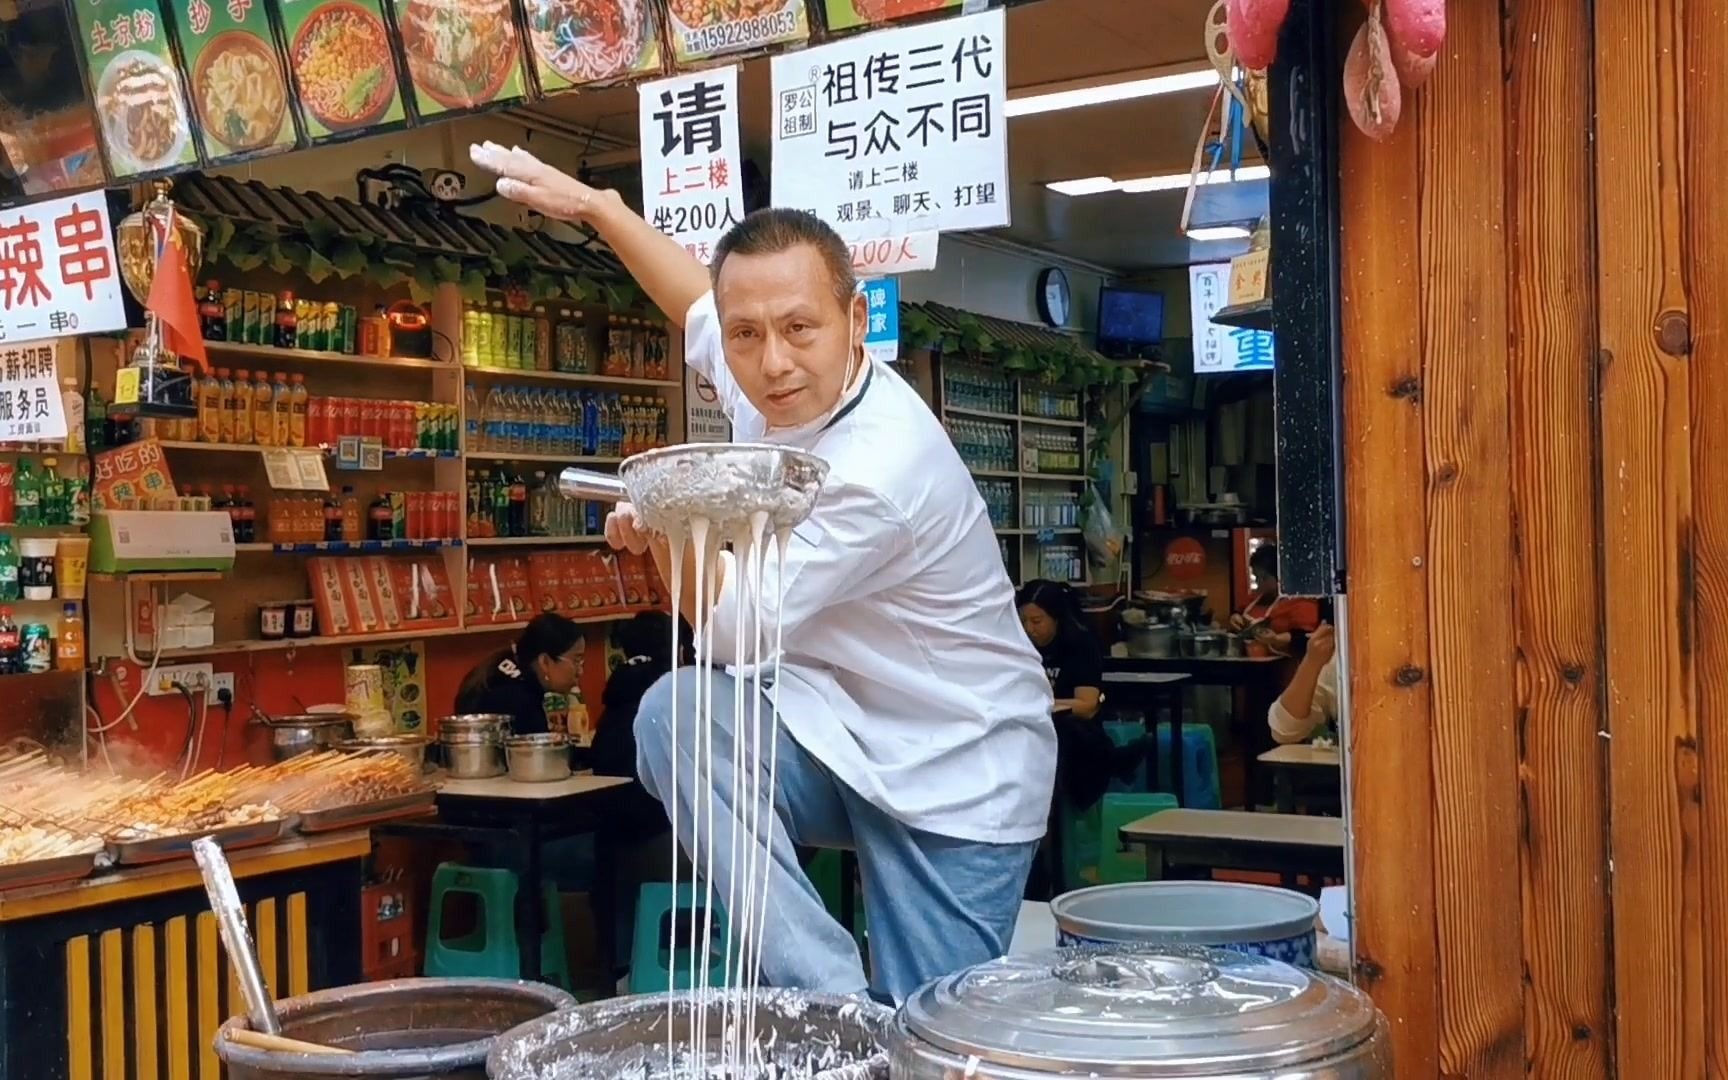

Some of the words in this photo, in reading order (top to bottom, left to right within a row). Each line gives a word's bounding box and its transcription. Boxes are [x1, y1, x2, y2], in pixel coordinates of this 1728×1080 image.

[700, 11, 796, 49] 15922988053
[822, 35, 992, 107] 祖传三代
[653, 81, 726, 158] 请
[784, 91, 813, 112] 罗公
[784, 114, 813, 134] 祖制
[825, 94, 991, 159] 与众不同
[659, 158, 729, 195] 上二楼
[848, 161, 918, 190] 请上二楼
[0, 386, 49, 420] 服务员
